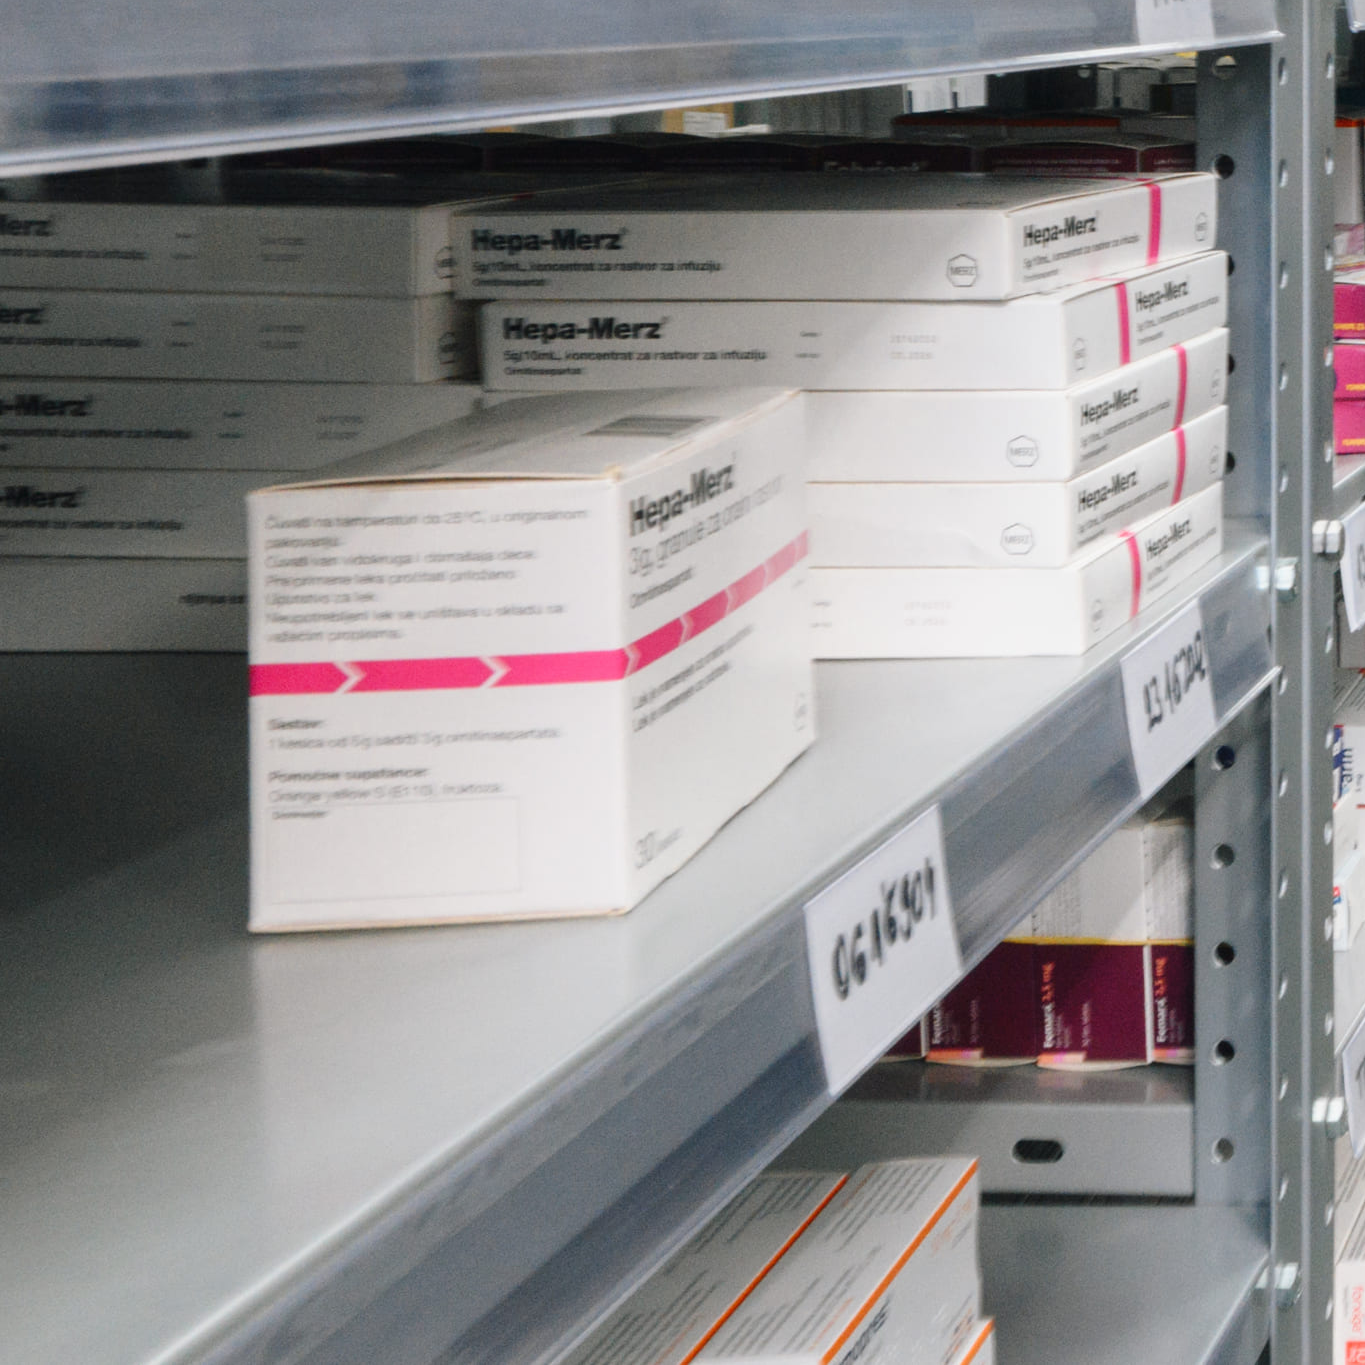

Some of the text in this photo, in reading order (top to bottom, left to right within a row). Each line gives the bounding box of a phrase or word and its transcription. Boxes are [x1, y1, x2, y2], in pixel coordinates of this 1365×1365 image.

[471, 228, 622, 255] Hepa-Merz
[1024, 217, 1097, 246] Hepa-Merz
[1135, 281, 1190, 311] Hepa-Merz
[503, 317, 661, 344] Hepa-Merz
[1081, 387, 1140, 428] Hepa-Merz
[629, 464, 735, 534] Hepa-Merz
[1078, 470, 1138, 513] Hepa-Merz
[1145, 519, 1192, 561] Hepa-Merz
